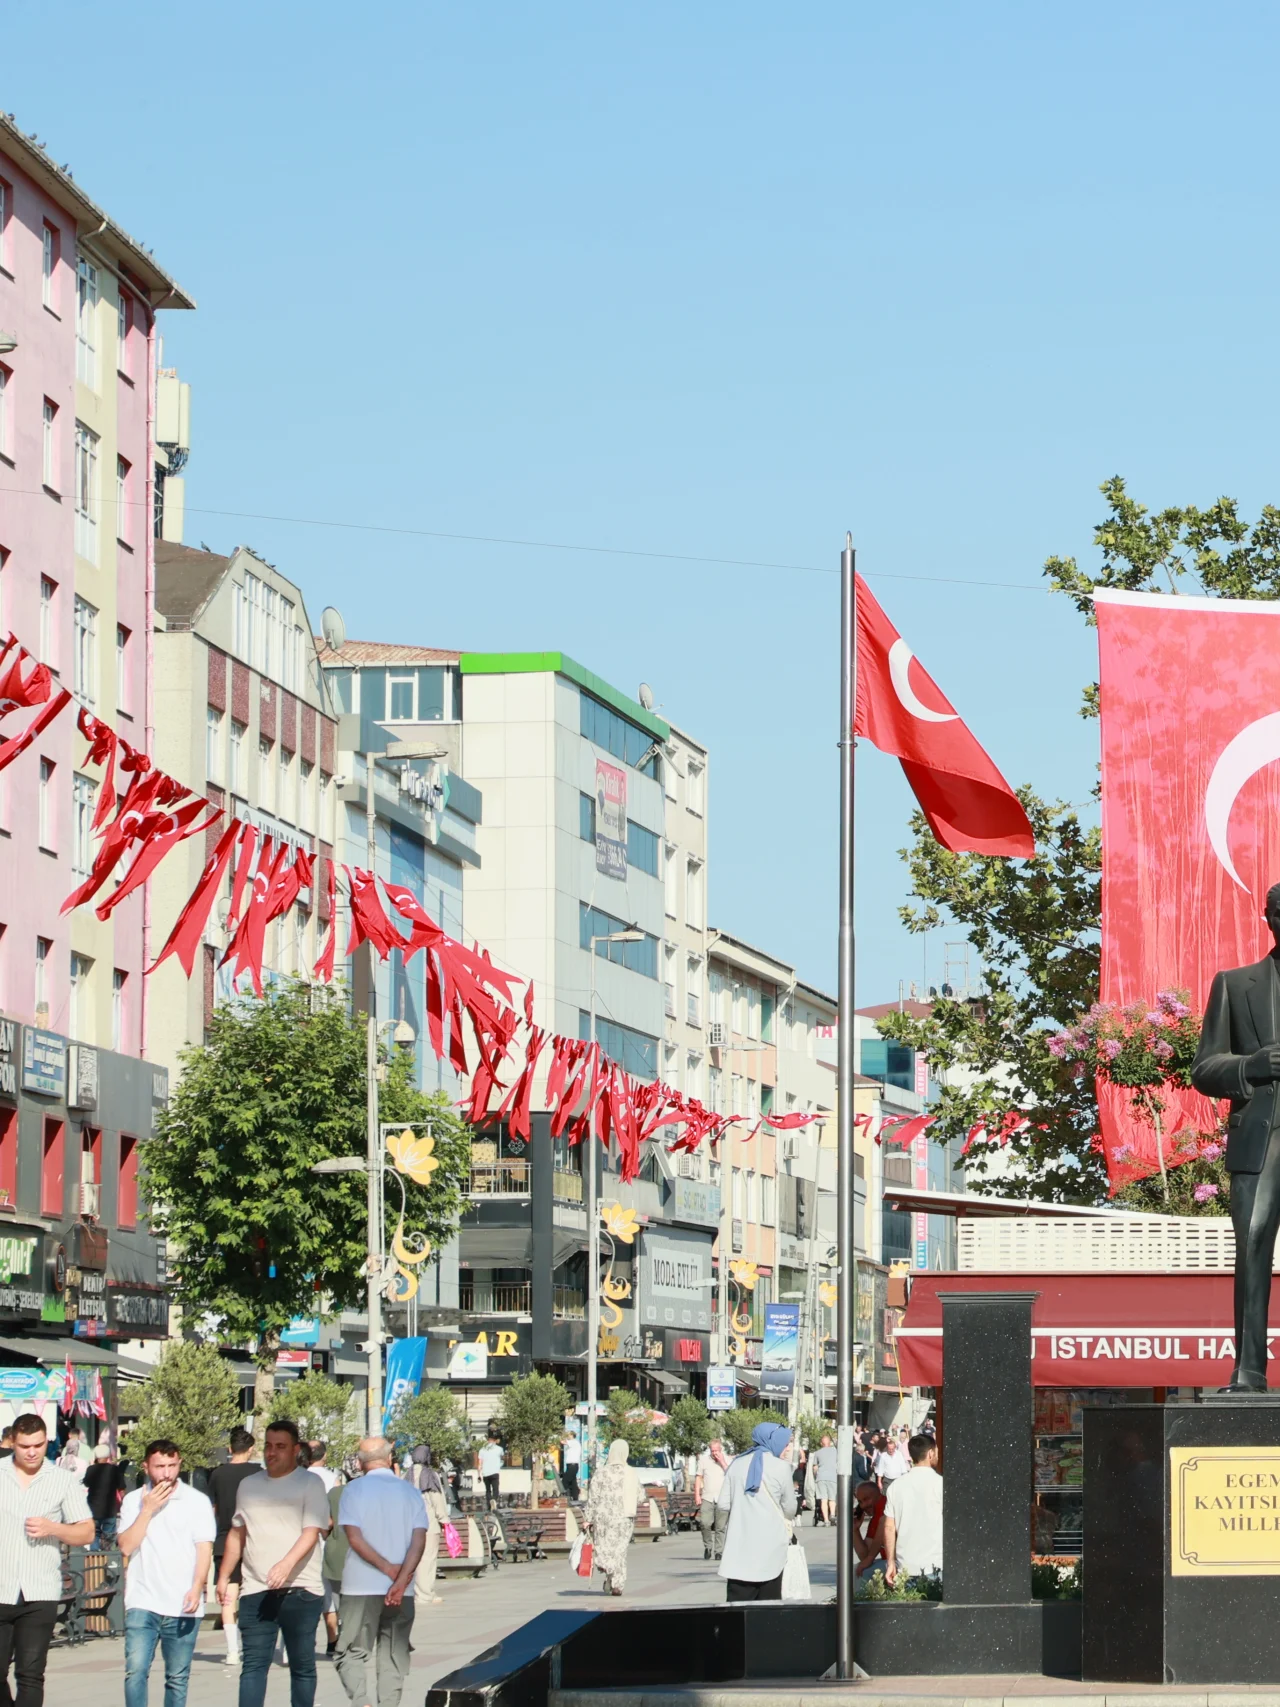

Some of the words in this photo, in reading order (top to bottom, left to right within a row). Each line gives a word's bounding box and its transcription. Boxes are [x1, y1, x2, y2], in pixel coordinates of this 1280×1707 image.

[654, 1258, 676, 1287] MODA
[1050, 1335, 1189, 1360] İSTANBUL
[1198, 1337, 1274, 1360] HAK
[765, 1383, 789, 1392] BYD
